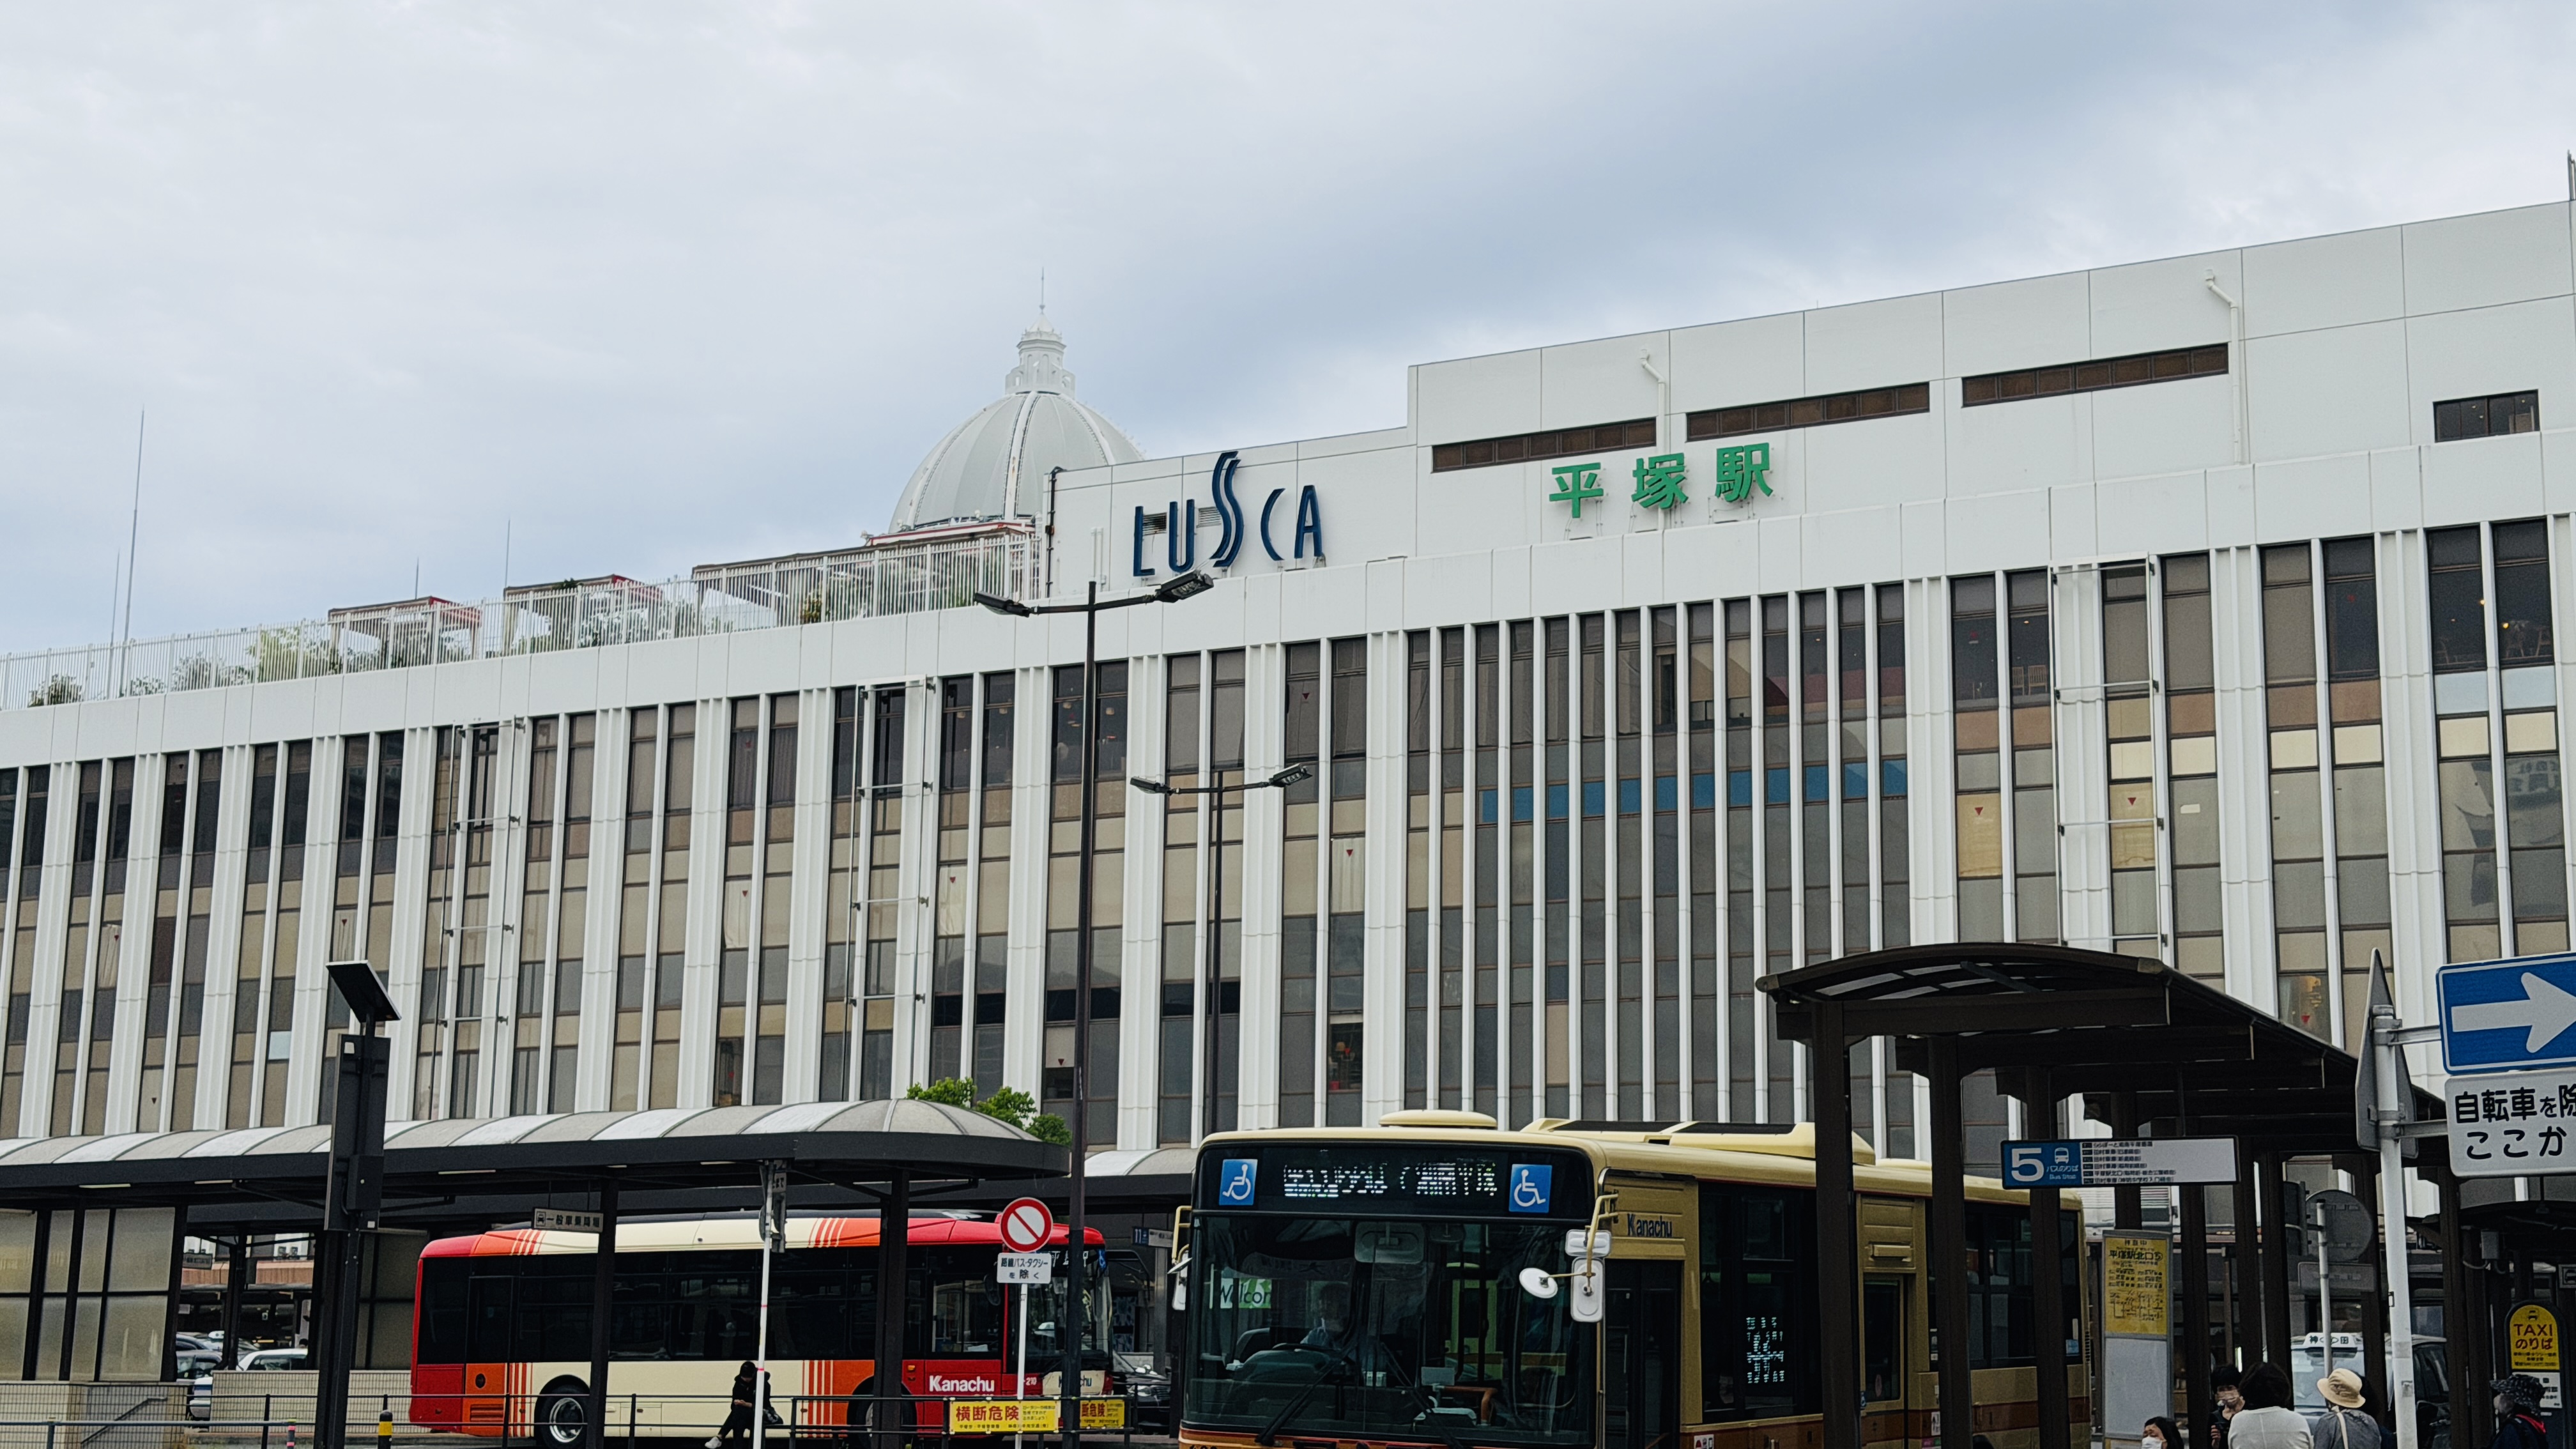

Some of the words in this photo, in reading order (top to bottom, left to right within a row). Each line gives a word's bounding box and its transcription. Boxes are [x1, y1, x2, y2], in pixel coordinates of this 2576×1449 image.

[1550, 442, 1774, 519] 平塚駅
[1133, 450, 1323, 577] LUSCA
[2011, 1147, 2044, 1182] 5
[1627, 1213, 1673, 1238] Kanachu
[2513, 1323, 2553, 1337] TAXI
[2515, 1337, 2553, 1350] のりば
[929, 1375, 995, 1392] Kanachu
[956, 1406, 1020, 1422] 横断危険
